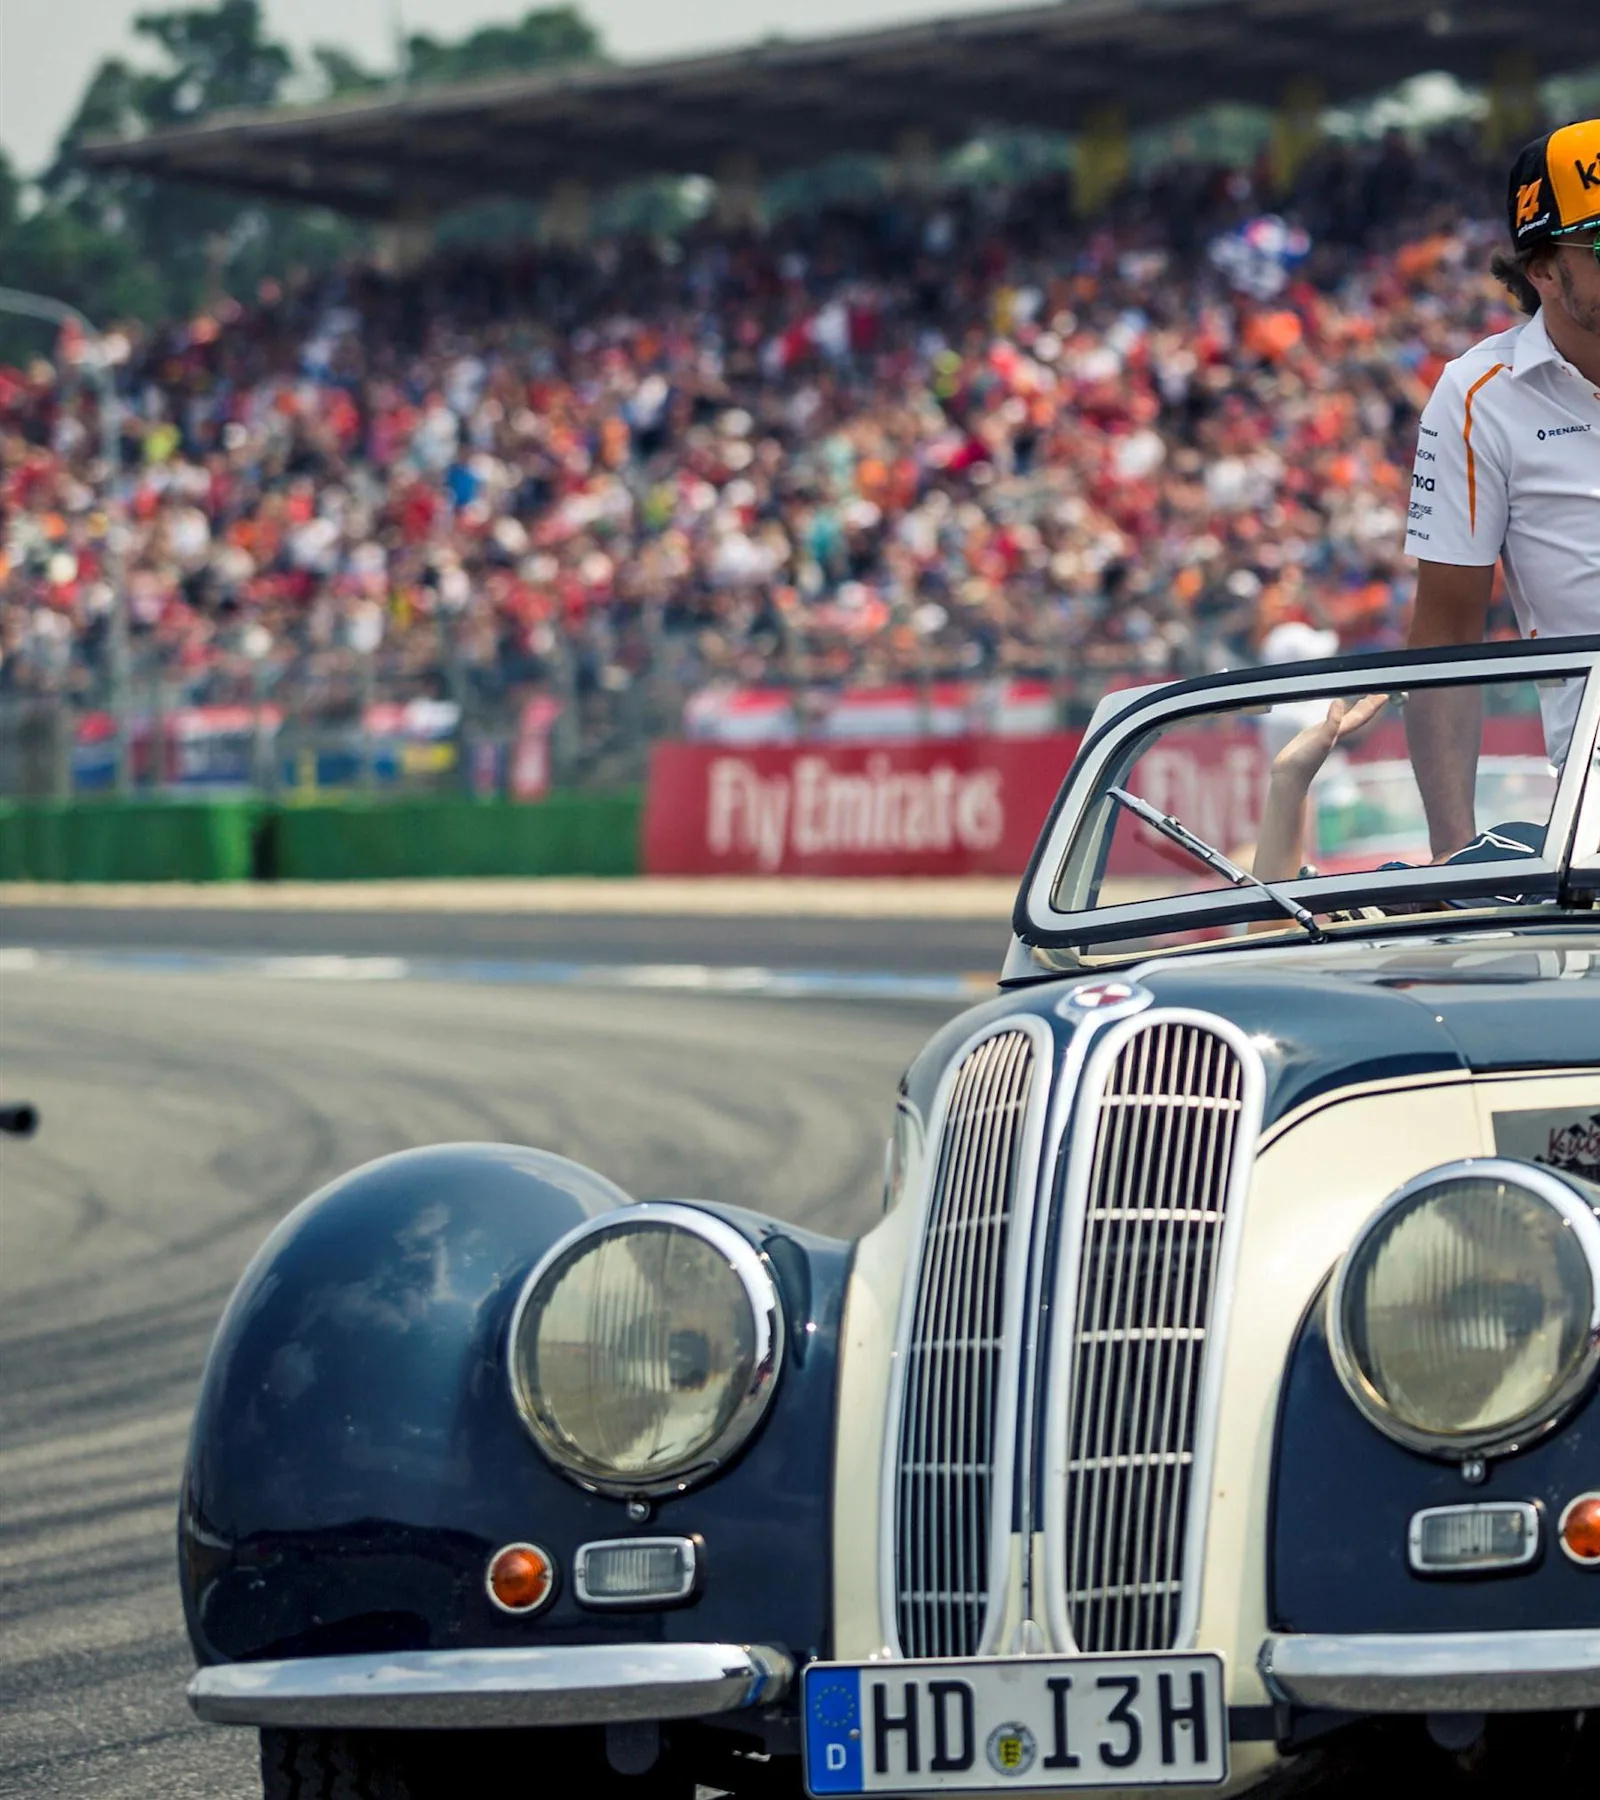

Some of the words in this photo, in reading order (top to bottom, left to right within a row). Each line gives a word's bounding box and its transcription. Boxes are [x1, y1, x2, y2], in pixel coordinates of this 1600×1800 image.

[1515, 178, 1543, 228] 14
[1548, 424, 1592, 437] RENAULT
[708, 756, 787, 870] Fly
[872, 1679, 976, 1774] HD
[1043, 1672, 1209, 1769] I3H
[826, 1743, 847, 1771] D
